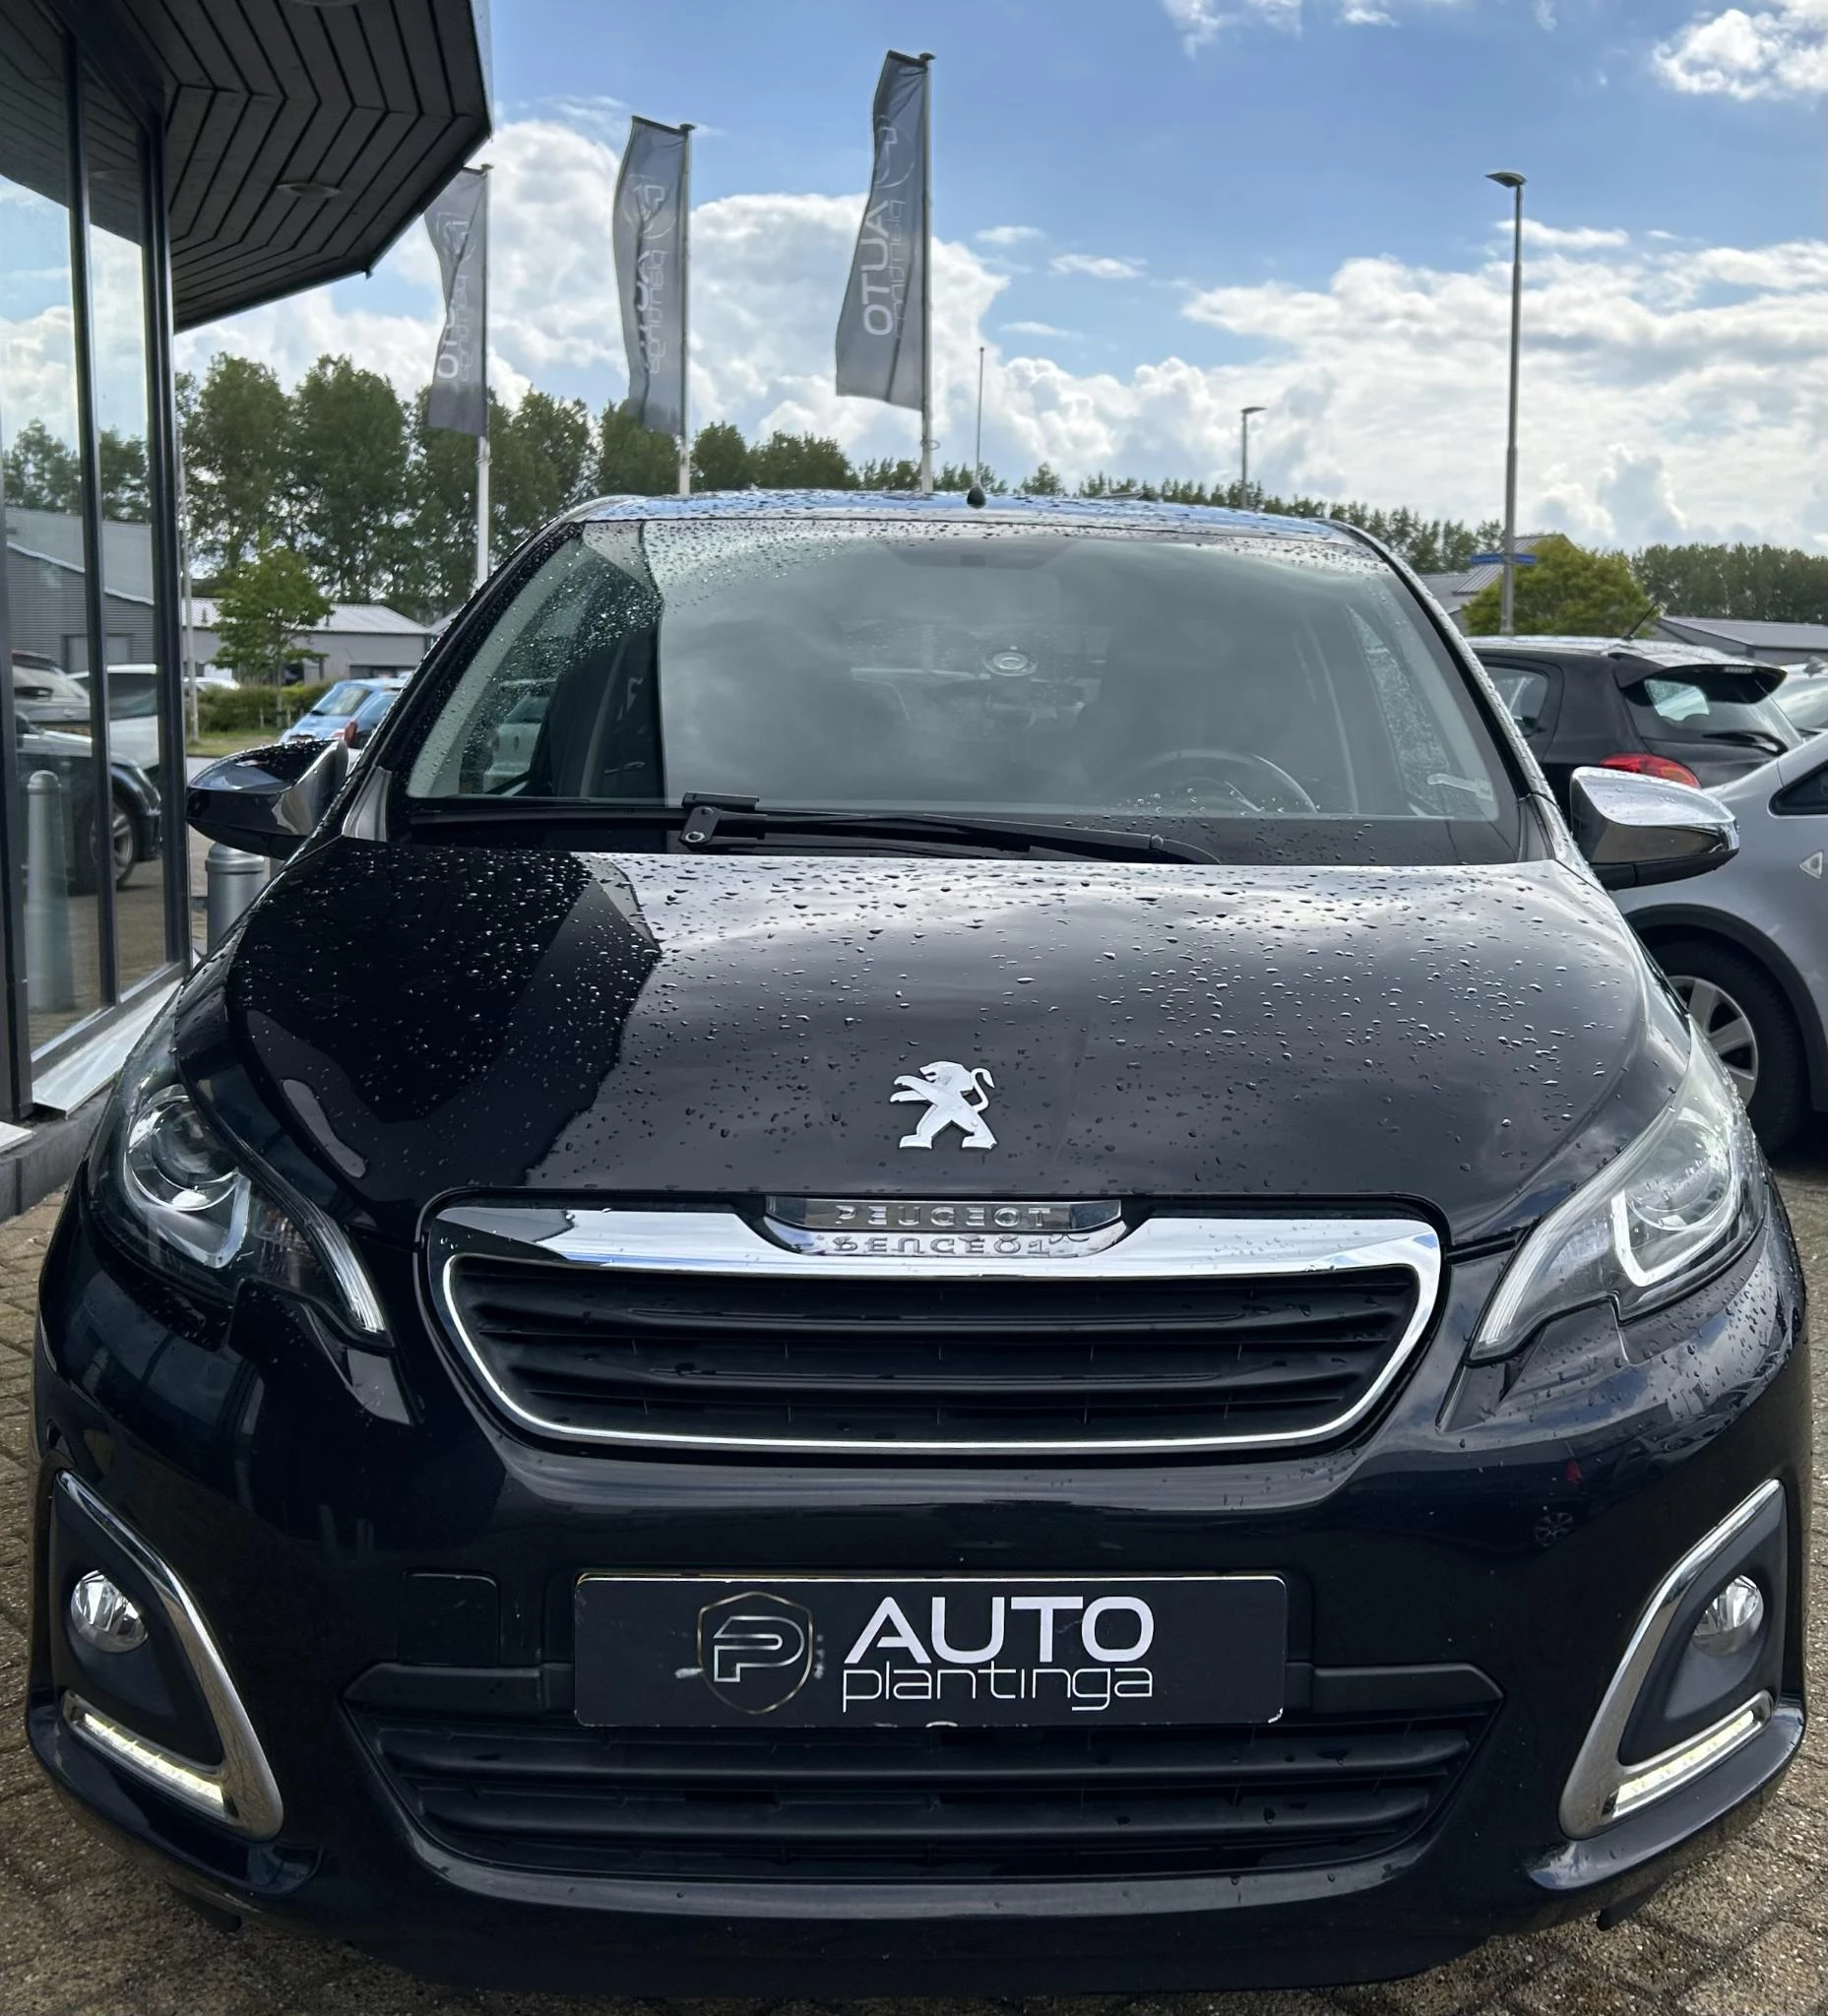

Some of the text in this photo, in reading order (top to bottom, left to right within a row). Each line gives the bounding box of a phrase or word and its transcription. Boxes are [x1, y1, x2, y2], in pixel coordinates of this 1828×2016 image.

[836, 1205, 1050, 1228] PEUGEOT
[844, 1596, 1154, 1664] AUTO
[843, 1661, 1153, 1713] plantinga
